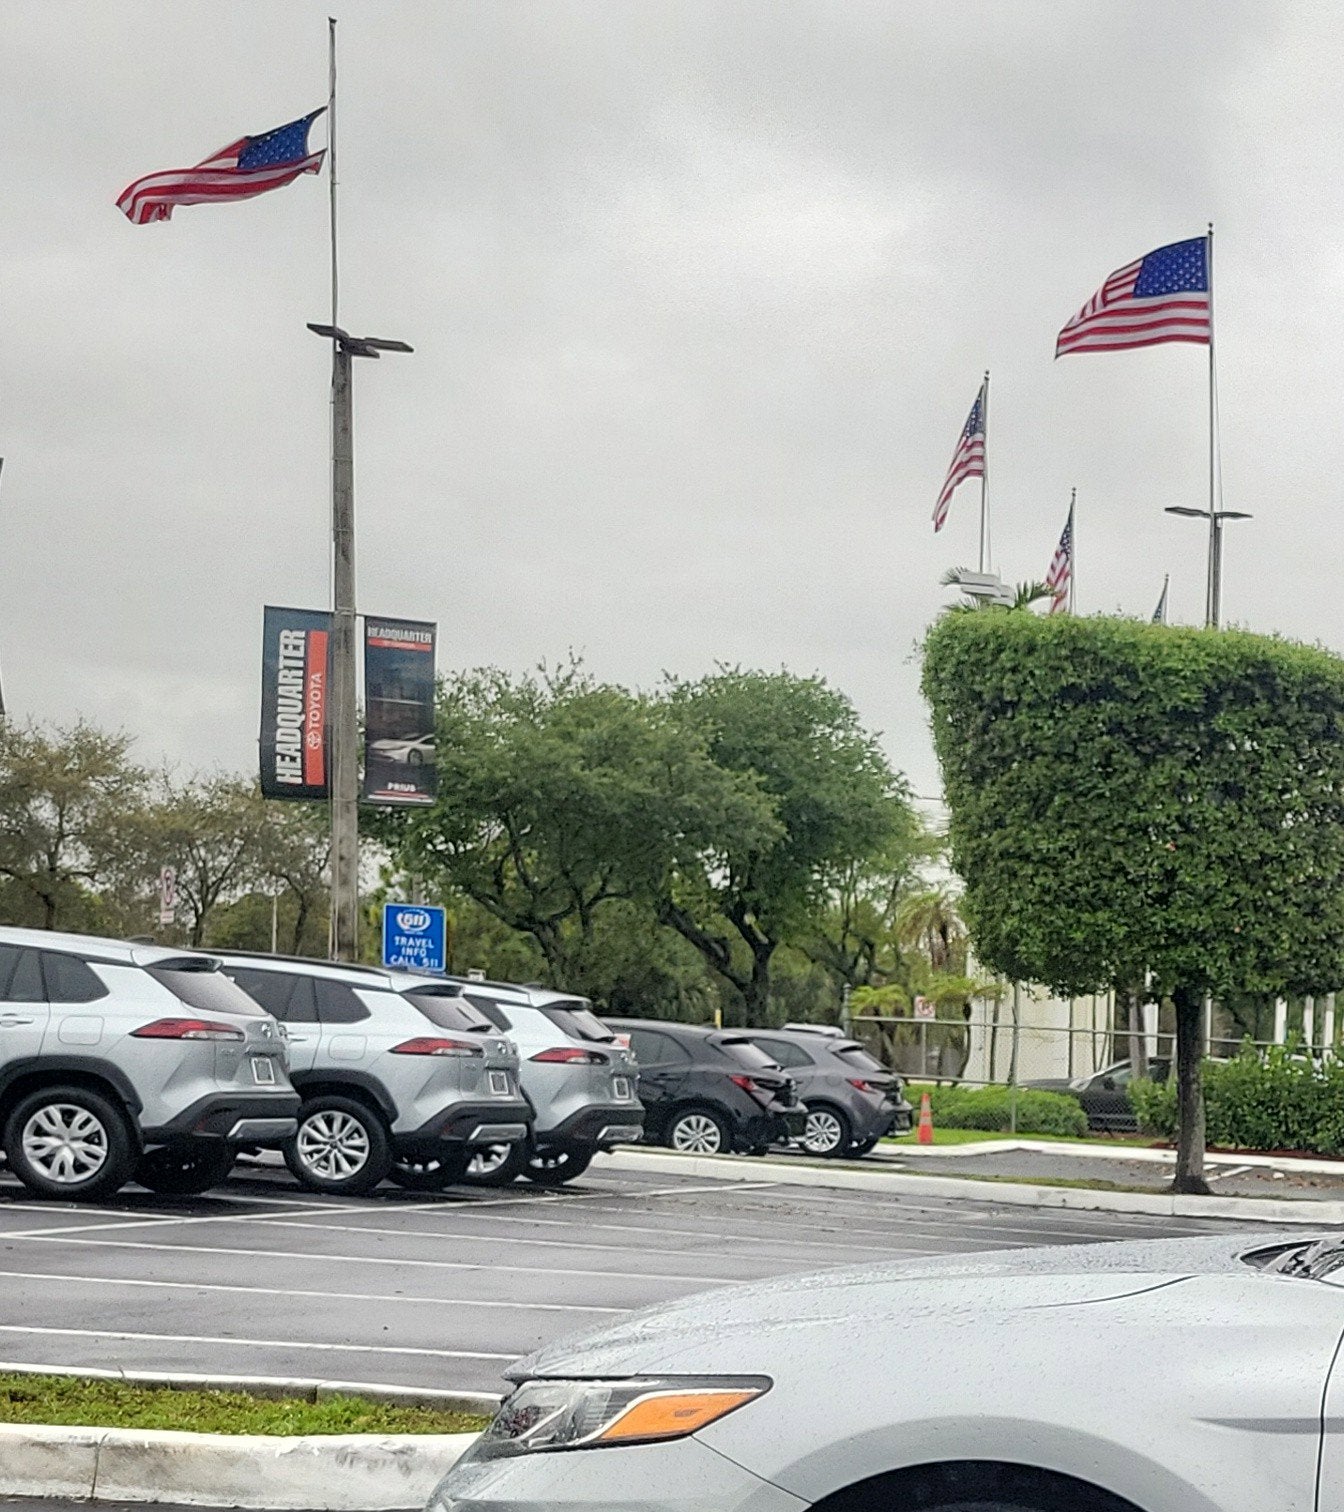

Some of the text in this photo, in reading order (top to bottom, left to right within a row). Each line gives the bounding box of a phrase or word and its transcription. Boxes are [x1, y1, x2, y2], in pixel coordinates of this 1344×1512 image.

[276, 629, 306, 784] HEADQUARTER
[309, 673, 322, 731] TOYOTA
[394, 935, 434, 949] TRAVEL
[401, 946, 427, 957] INFO
[390, 954, 417, 967] CALL
